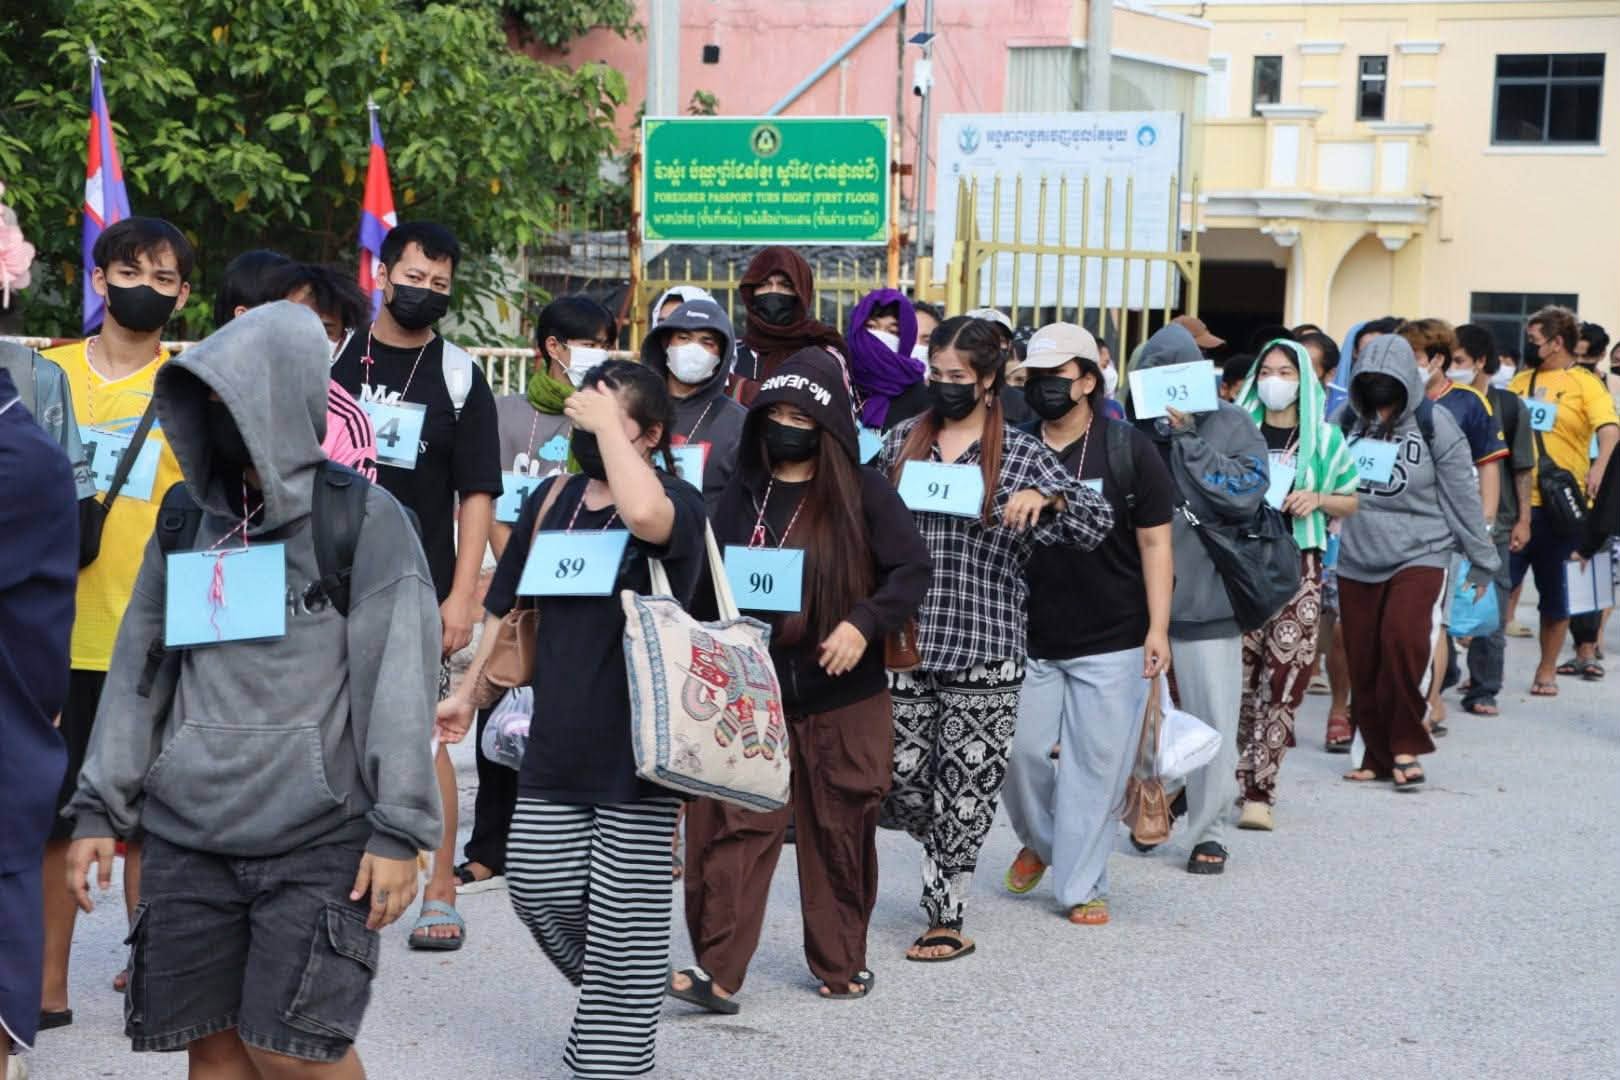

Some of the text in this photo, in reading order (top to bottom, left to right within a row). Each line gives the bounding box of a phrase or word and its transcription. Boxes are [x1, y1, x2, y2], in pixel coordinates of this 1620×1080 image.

[708, 191, 753, 204] PASSPORT
[755, 191, 781, 204] TURN
[782, 191, 811, 204] RIGHT
[760, 374, 810, 391] JEANS
[1166, 384, 1190, 402] 93
[376, 416, 401, 448] 4
[1358, 455, 1375, 471] 95
[927, 481, 951, 500] 91
[555, 557, 585, 579] 89
[748, 572, 773, 594] 90
